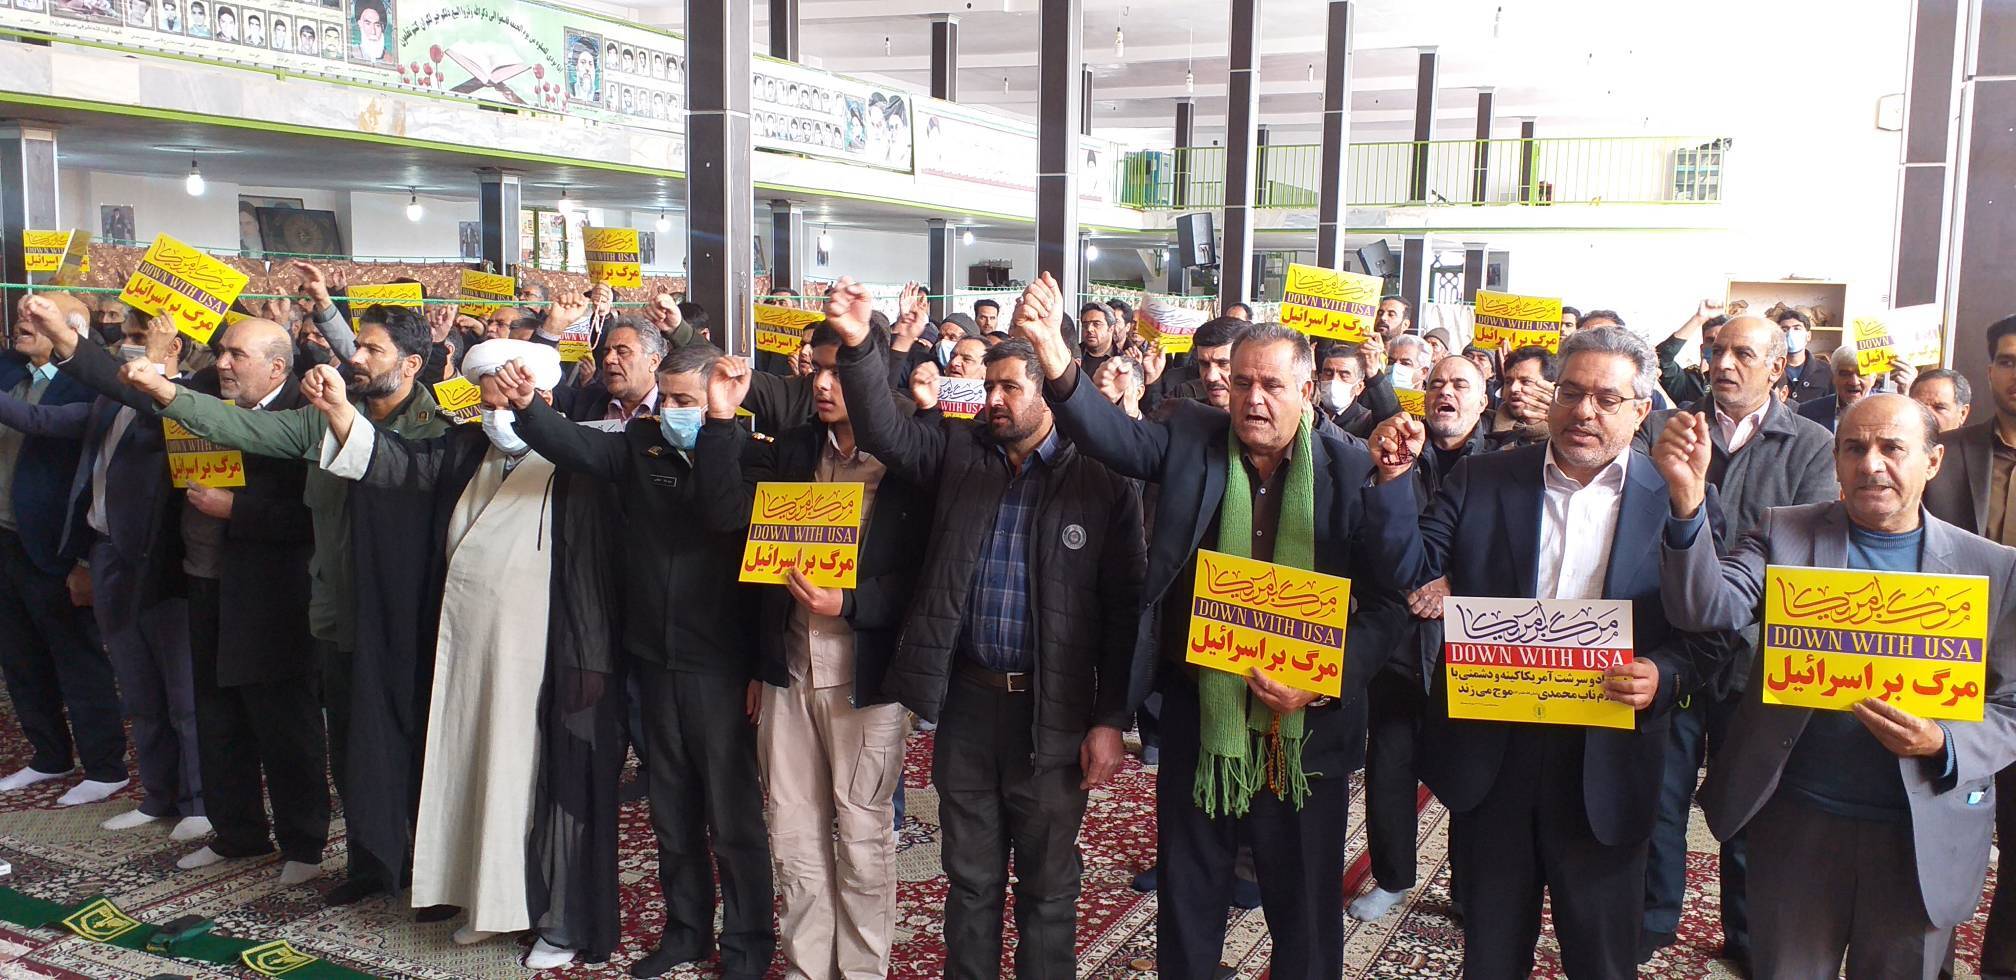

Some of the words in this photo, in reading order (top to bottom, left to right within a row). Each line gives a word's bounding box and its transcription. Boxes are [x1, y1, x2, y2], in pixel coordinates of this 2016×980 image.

[618, 253, 636, 262] USA
[616, 266, 639, 281] مرگ
[126, 277, 172, 305] اسرائیل
[140, 261, 169, 283] DOWN
[169, 275, 198, 300] WITH
[198, 291, 221, 313] USA
[1287, 292, 1318, 306] DOWN
[1320, 298, 1347, 312] WITH
[1351, 303, 1371, 316] USA
[182, 309, 214, 331] مرگ
[1281, 307, 1328, 328] اسرائیل
[1327, 319, 1340, 332] بر
[1478, 315, 1505, 327] DOWN
[1507, 319, 1532, 330] WITH
[1536, 321, 1555, 331] USA
[1343, 319, 1370, 337] مرگ
[1859, 335, 1889, 350] DOWN
[940, 401, 963, 412] WITH
[200, 461, 211, 480] بر
[214, 455, 241, 479] مرگ
[753, 525, 791, 540] DOWN
[794, 526, 823, 542] WITH
[827, 527, 853, 543] USA
[745, 543, 803, 575] اسرائیل
[802, 554, 816, 576] بر
[820, 549, 855, 578] مرگ
[1198, 599, 1248, 624] DOWN
[1252, 612, 1296, 637] WITH
[1302, 623, 1337, 646] USA
[1191, 624, 1267, 662] اسرائیل
[1774, 626, 1843, 651] DOWN
[1850, 632, 1913, 656] WITH
[1924, 637, 1975, 661] USA
[1264, 649, 1286, 672] بر
[1291, 649, 1339, 682] مرگ
[1450, 643, 1513, 665] DOWN
[1519, 646, 1573, 668] WITH
[1582, 649, 1625, 669] USA
[1451, 667, 1459, 680] با
[1458, 668, 1494, 681] دشمنی
[1494, 674, 1500, 683] و
[1500, 670, 1521, 682] کینه
[1520, 670, 1553, 685] آمریکا
[1555, 673, 1588, 687] سرشت
[1589, 676, 1595, 687] و
[1767, 653, 1873, 697] اسرائیل
[1492, 687, 1513, 698] موج
[1537, 690, 1578, 701] محمدی
[1578, 689, 1596, 703] ناب
[1877, 673, 1904, 703] بر
[1912, 667, 1979, 707] مرگ
